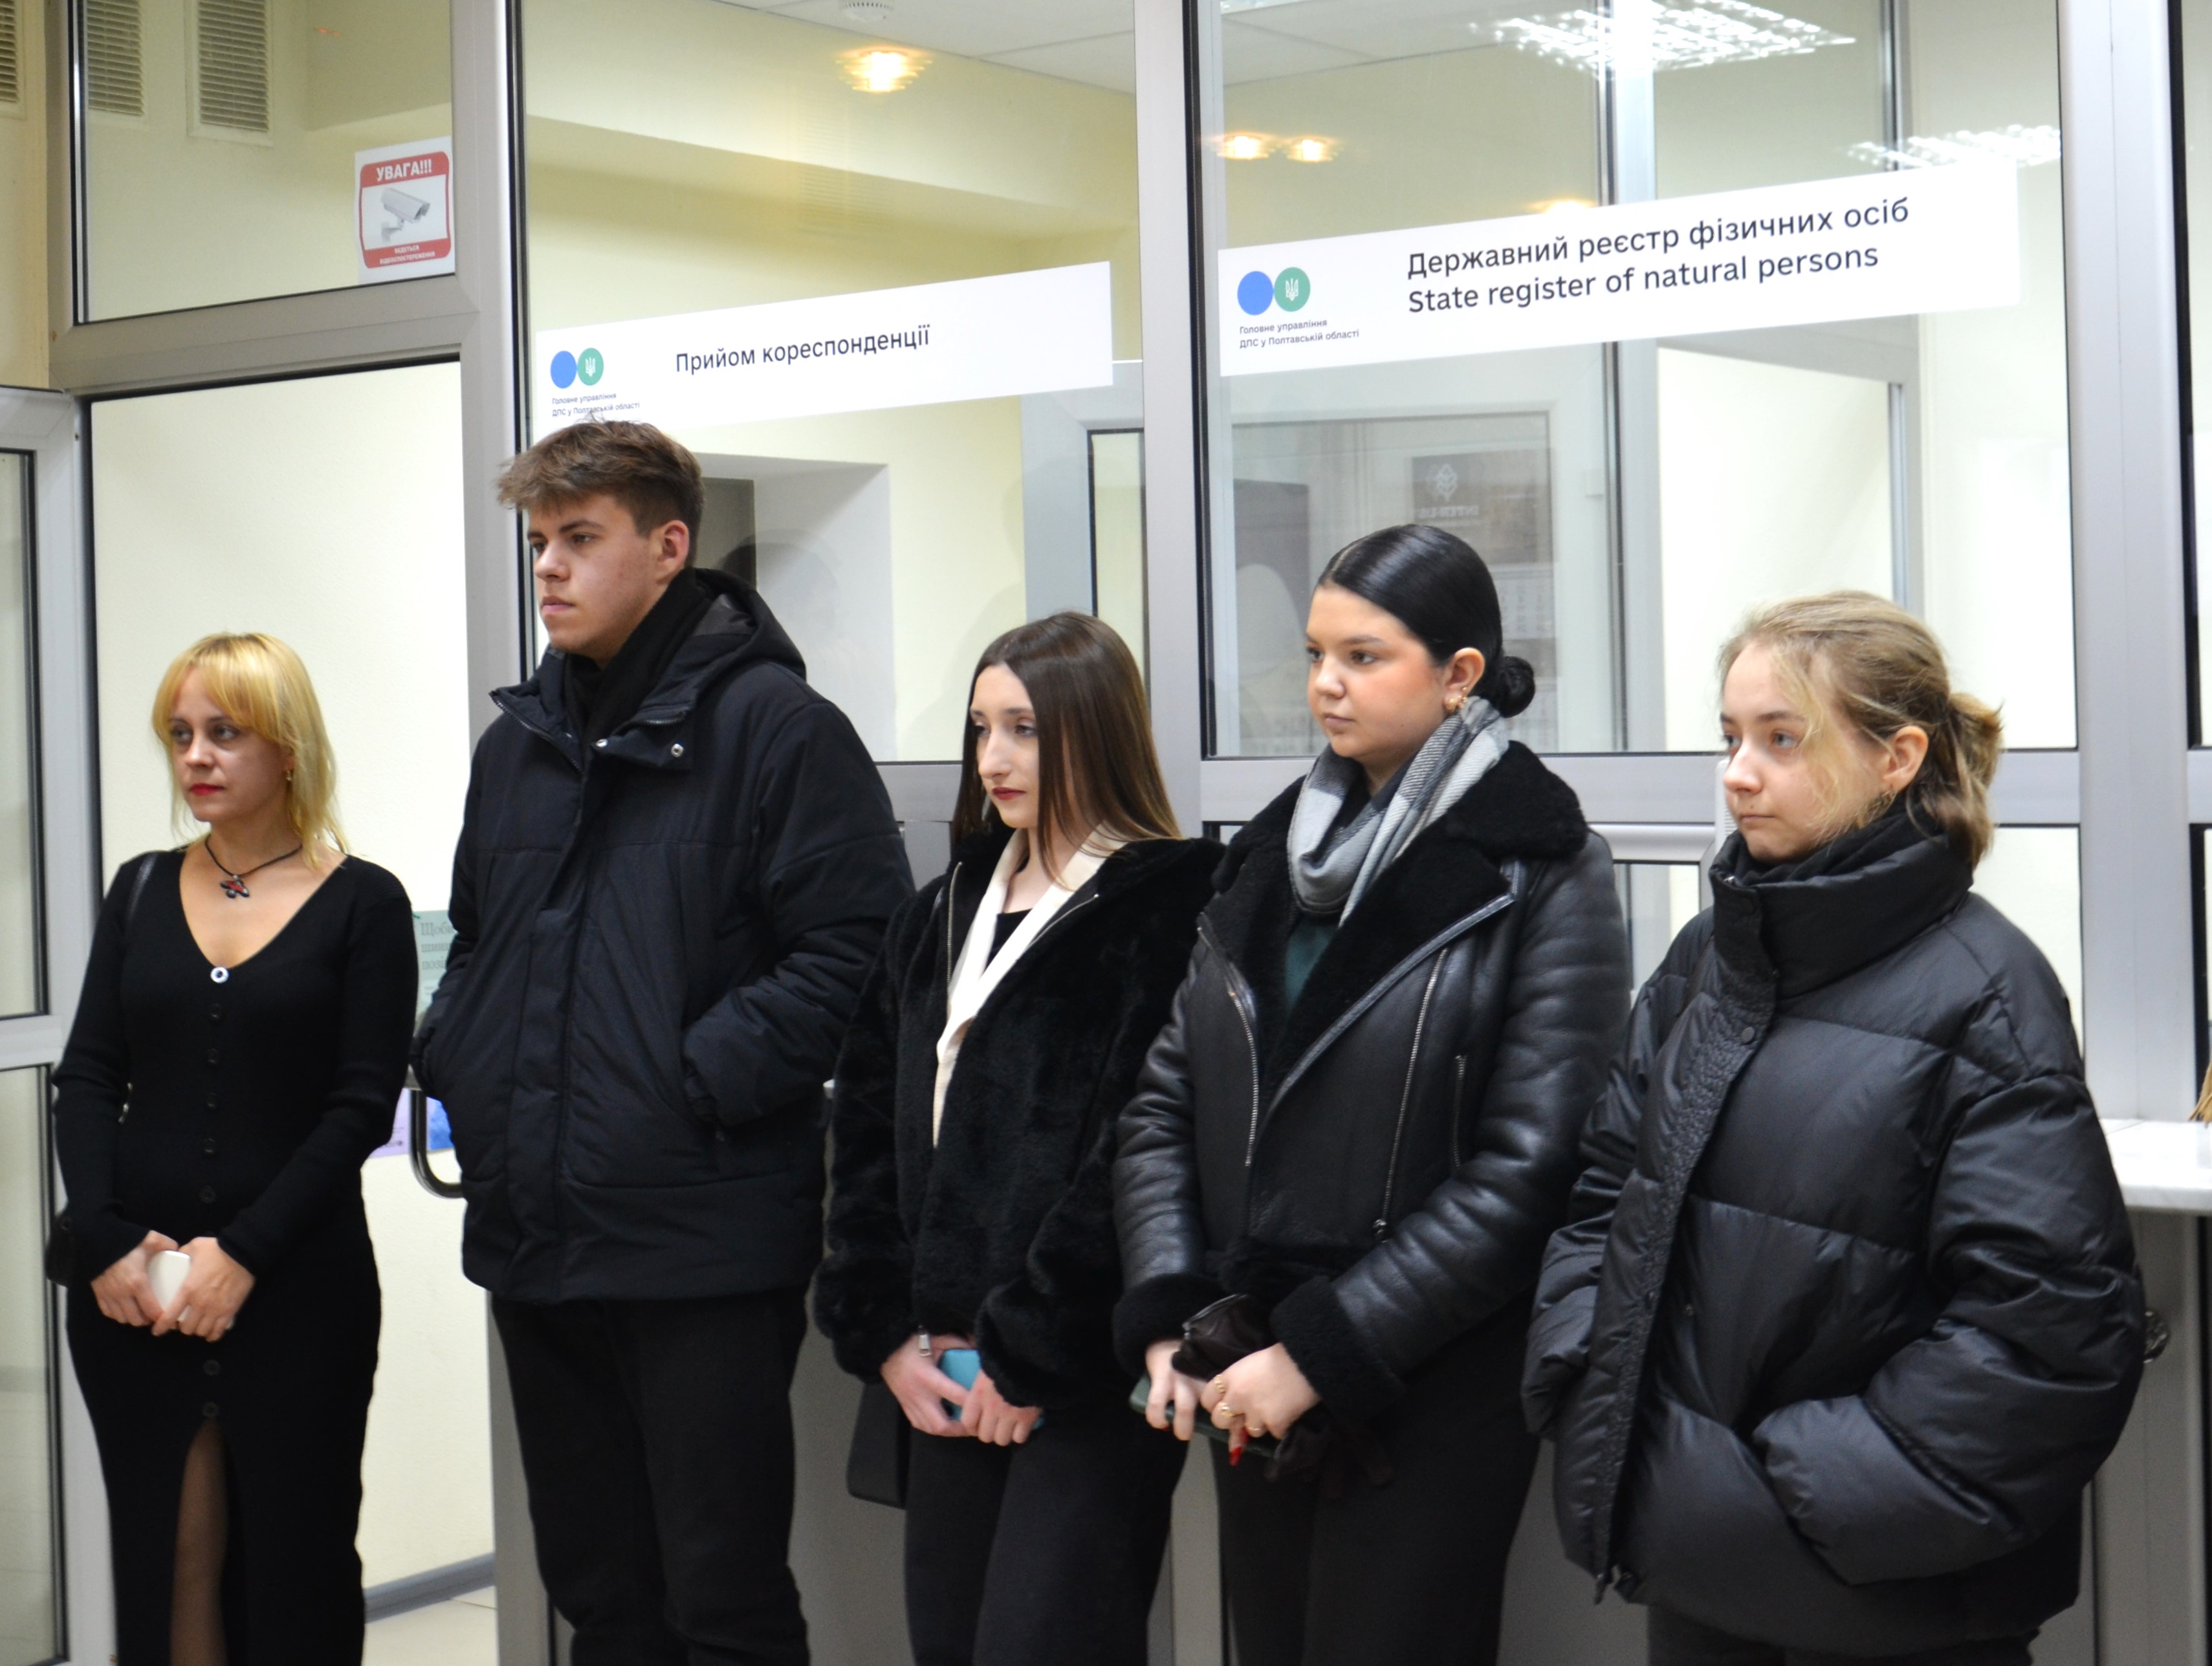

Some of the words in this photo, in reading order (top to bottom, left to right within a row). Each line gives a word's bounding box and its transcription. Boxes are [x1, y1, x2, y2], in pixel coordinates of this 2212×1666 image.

[377, 159, 432, 182] УВАГА!!!
[1408, 236, 1568, 280] Державний
[1579, 230, 1680, 263] реєстр
[1689, 212, 1833, 250] фізичних
[1844, 197, 1909, 226] осіб
[1409, 287, 1478, 312] State
[1489, 276, 1596, 308] register
[1606, 267, 1636, 293] of
[1645, 256, 1747, 289] natural
[1759, 248, 1879, 283] persons
[1240, 325, 1275, 334] Головне
[1277, 320, 1328, 333] управління
[676, 348, 756, 375] Прийом
[762, 324, 931, 365] кореспонденції
[1240, 338, 1259, 349] ДПС
[1268, 333, 1323, 345] Полтавській
[1325, 329, 1359, 340] області
[552, 397, 578, 405] Головне
[580, 393, 617, 403] управління
[552, 408, 567, 417] ДПС
[615, 401, 641, 411] області
